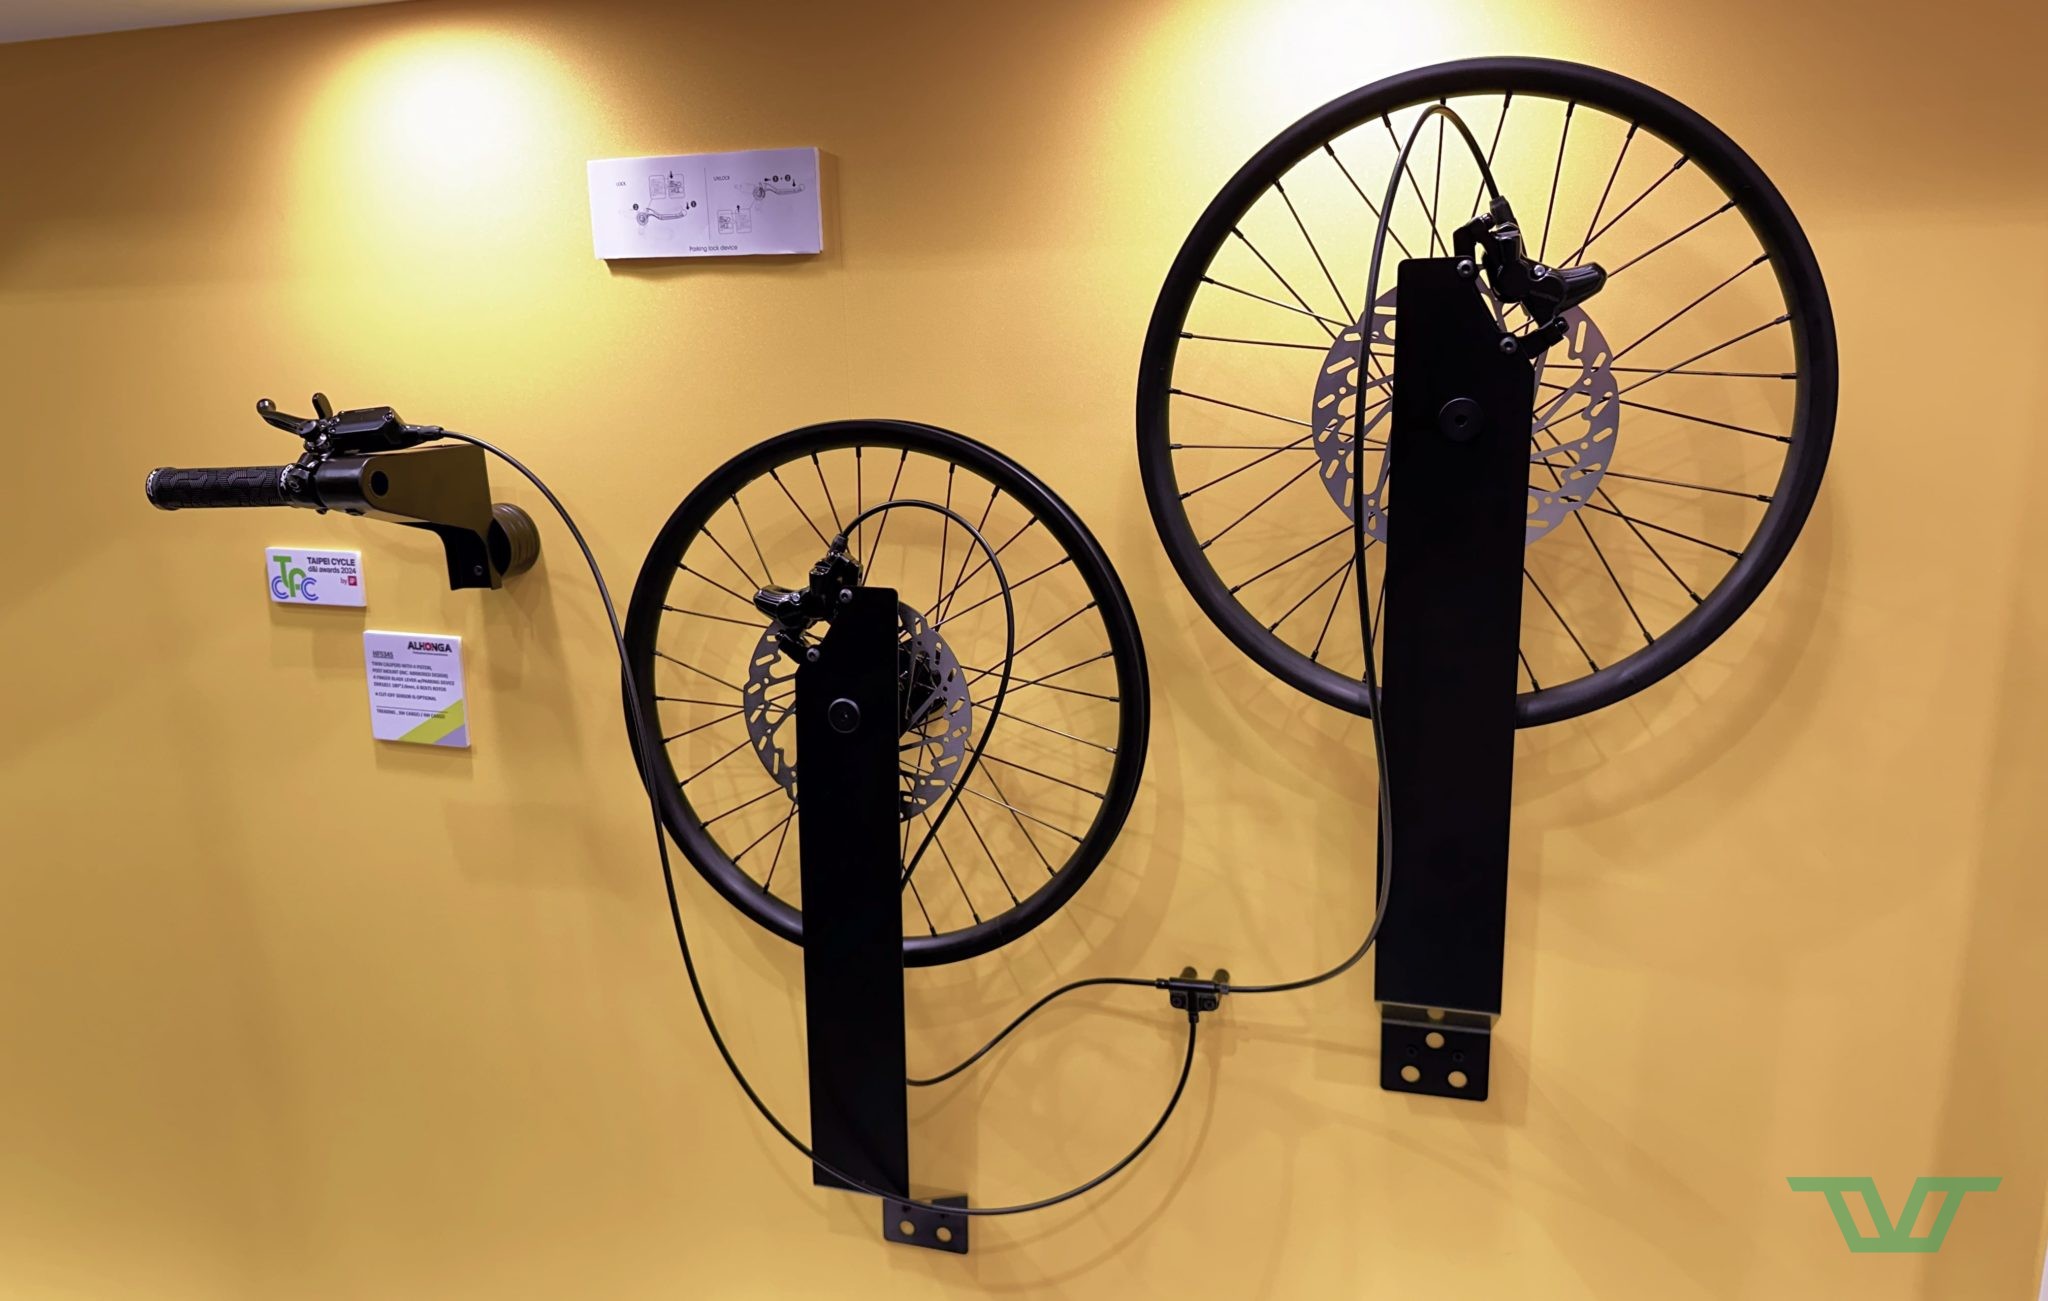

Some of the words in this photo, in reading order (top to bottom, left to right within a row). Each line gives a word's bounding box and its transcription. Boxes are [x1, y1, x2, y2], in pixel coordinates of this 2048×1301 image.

[307, 556, 331, 566] TAIPEI
[331, 557, 356, 567] CYCLE
[319, 566, 340, 574] awards
[340, 567, 357, 575] 2024
[340, 577, 347, 586] by
[407, 641, 452, 653] ALHONGA
